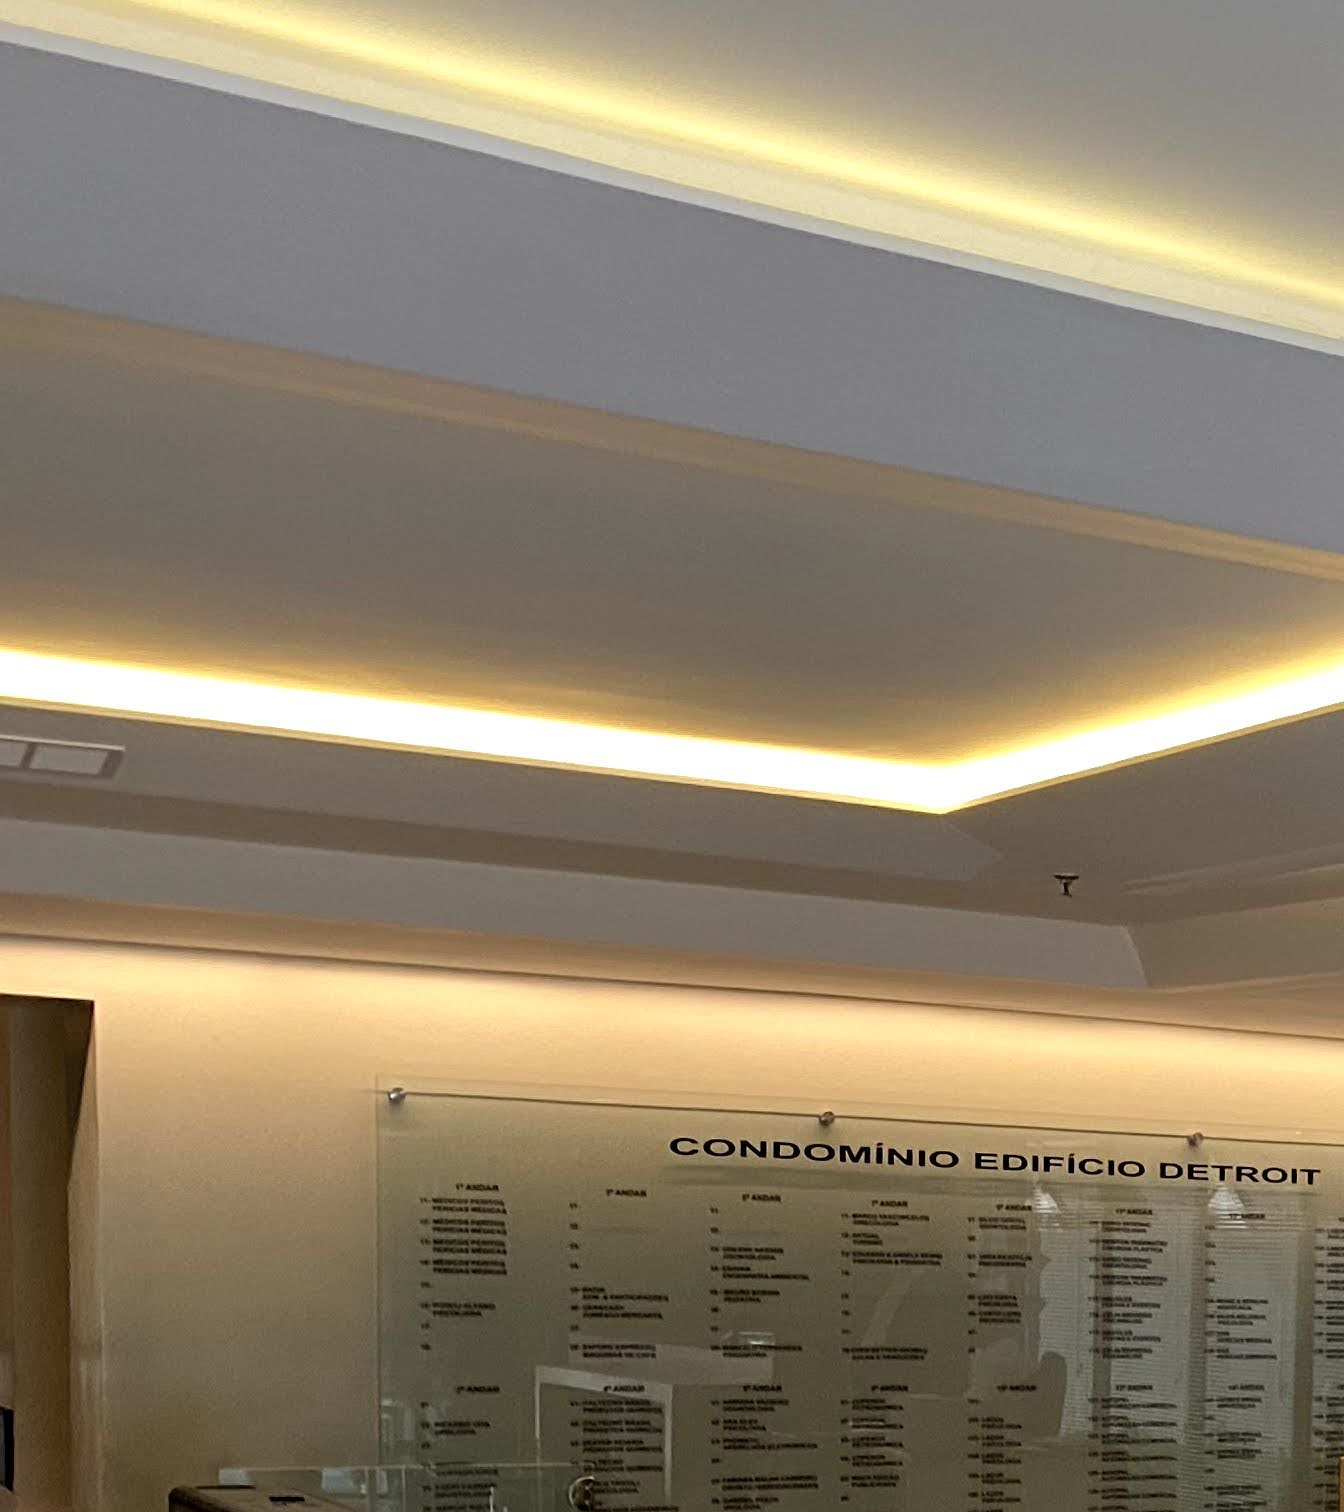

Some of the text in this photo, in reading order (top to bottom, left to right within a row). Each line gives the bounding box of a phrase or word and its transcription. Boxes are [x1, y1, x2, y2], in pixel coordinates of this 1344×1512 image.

[669, 1137, 1321, 1185] CONDOMÍNIO EDIFÍCIO DETROIT
